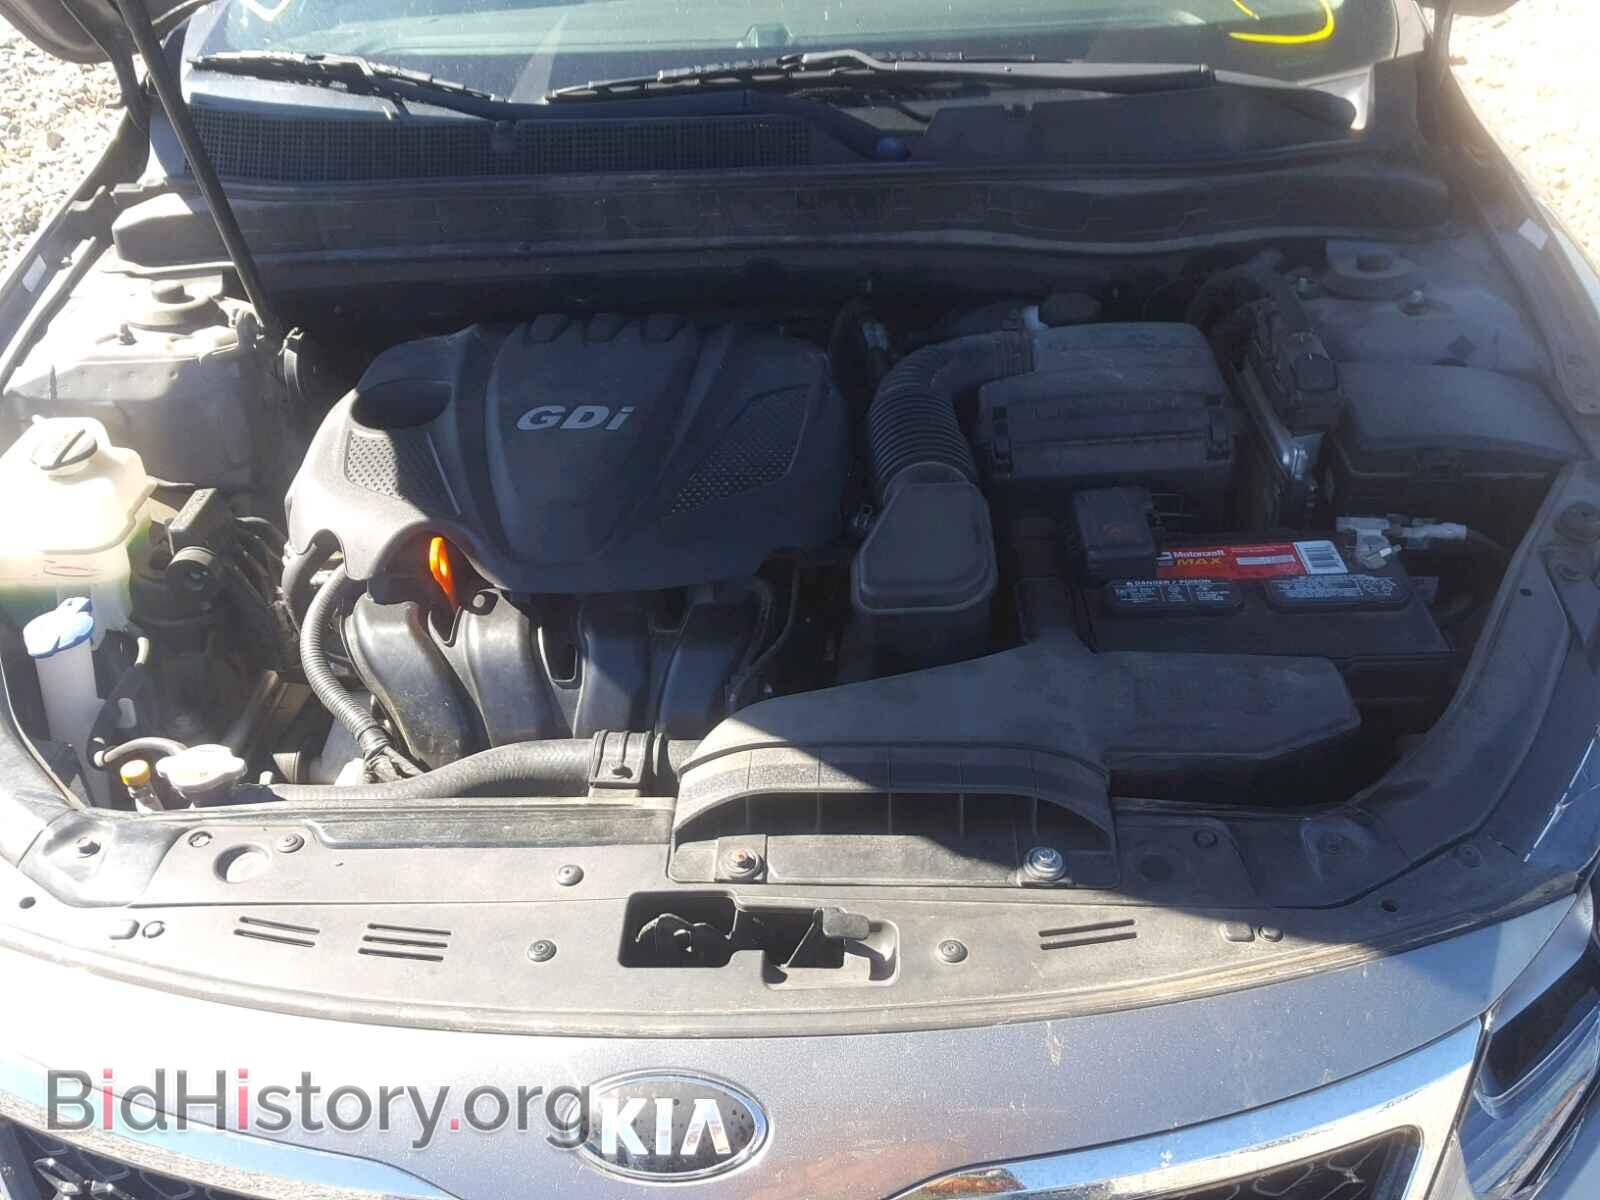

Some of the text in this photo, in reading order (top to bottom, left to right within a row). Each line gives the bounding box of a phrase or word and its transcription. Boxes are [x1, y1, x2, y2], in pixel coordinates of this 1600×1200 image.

[516, 405, 635, 430] GDi
[1173, 549, 1225, 559] Motorcraft
[1177, 558, 1222, 566] MAX
[600, 1098, 732, 1155] KIA
